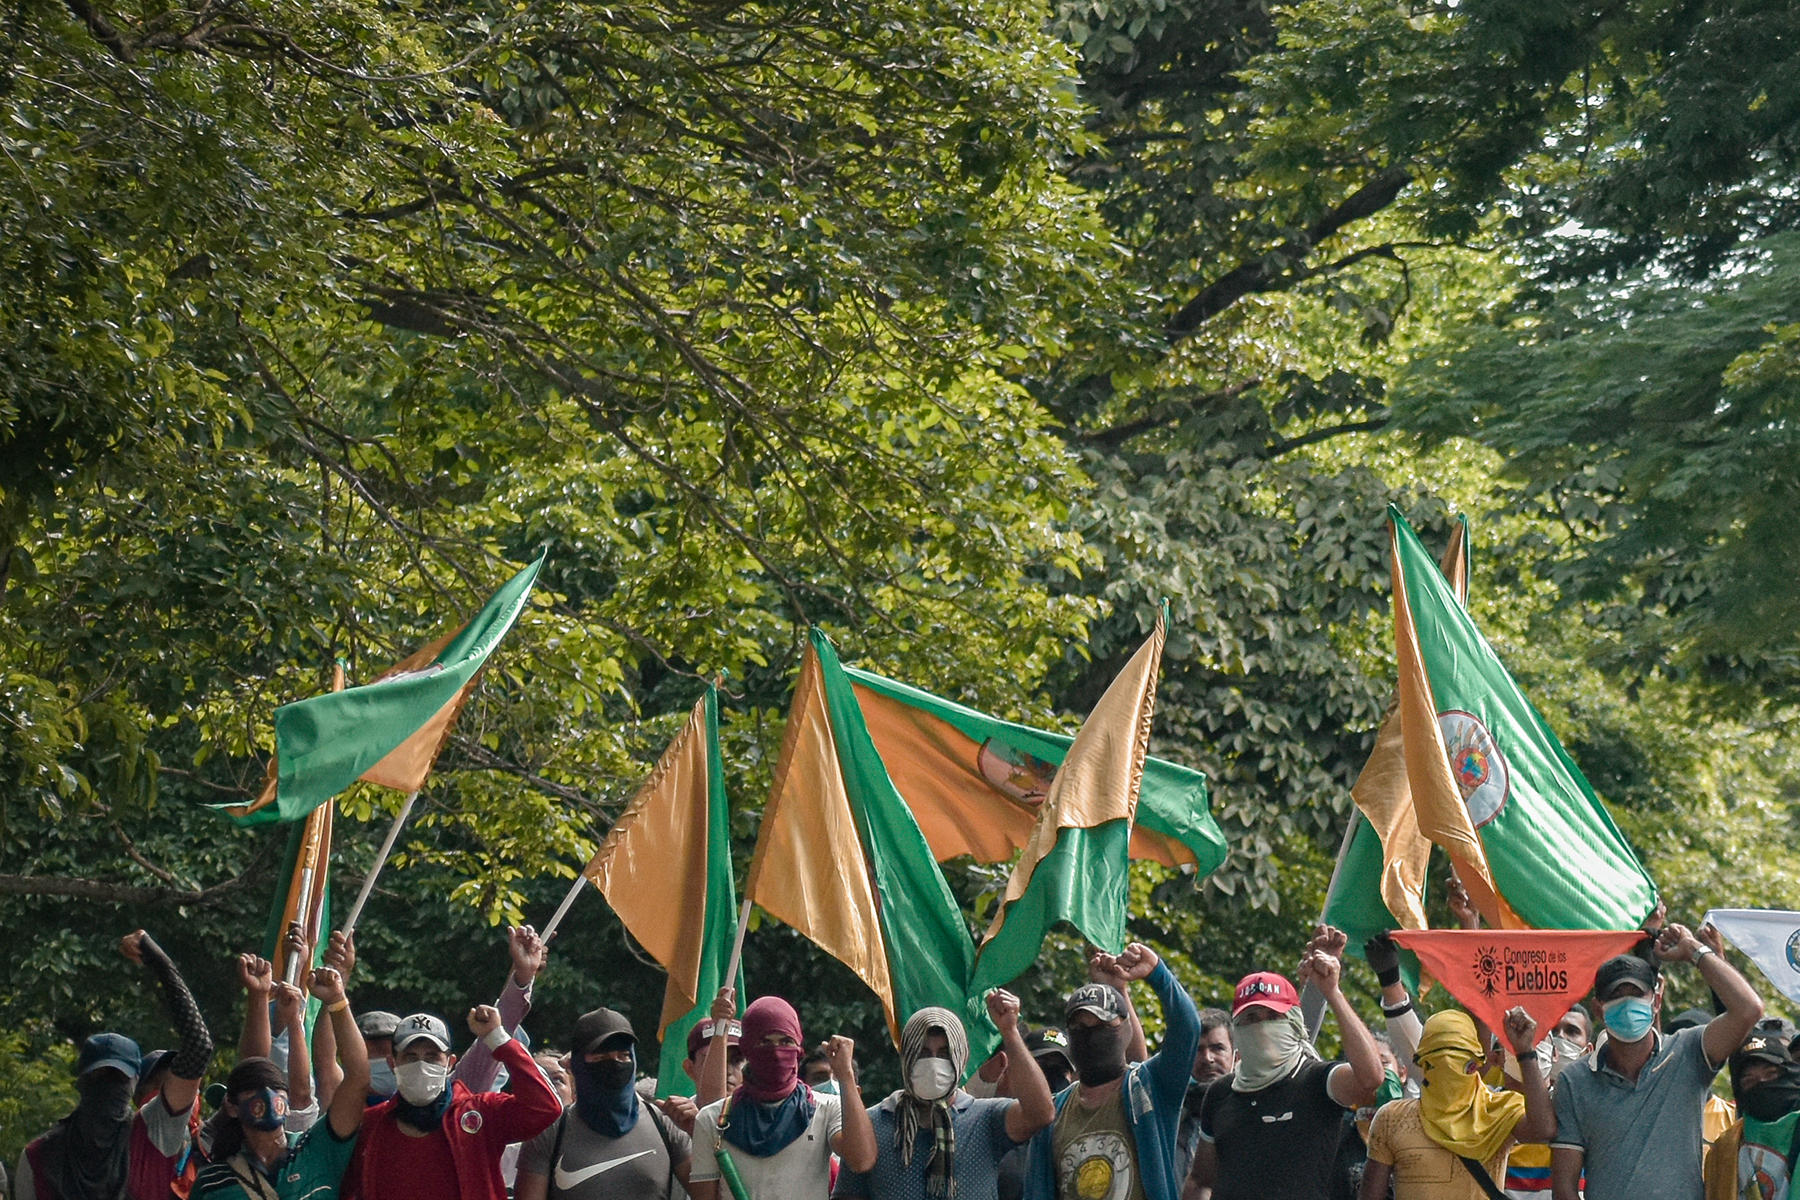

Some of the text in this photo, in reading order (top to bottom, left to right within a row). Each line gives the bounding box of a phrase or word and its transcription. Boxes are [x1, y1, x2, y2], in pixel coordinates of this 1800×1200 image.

[1504, 947, 1567, 968] Congreso de los
[1505, 965, 1568, 991] Pueblos
